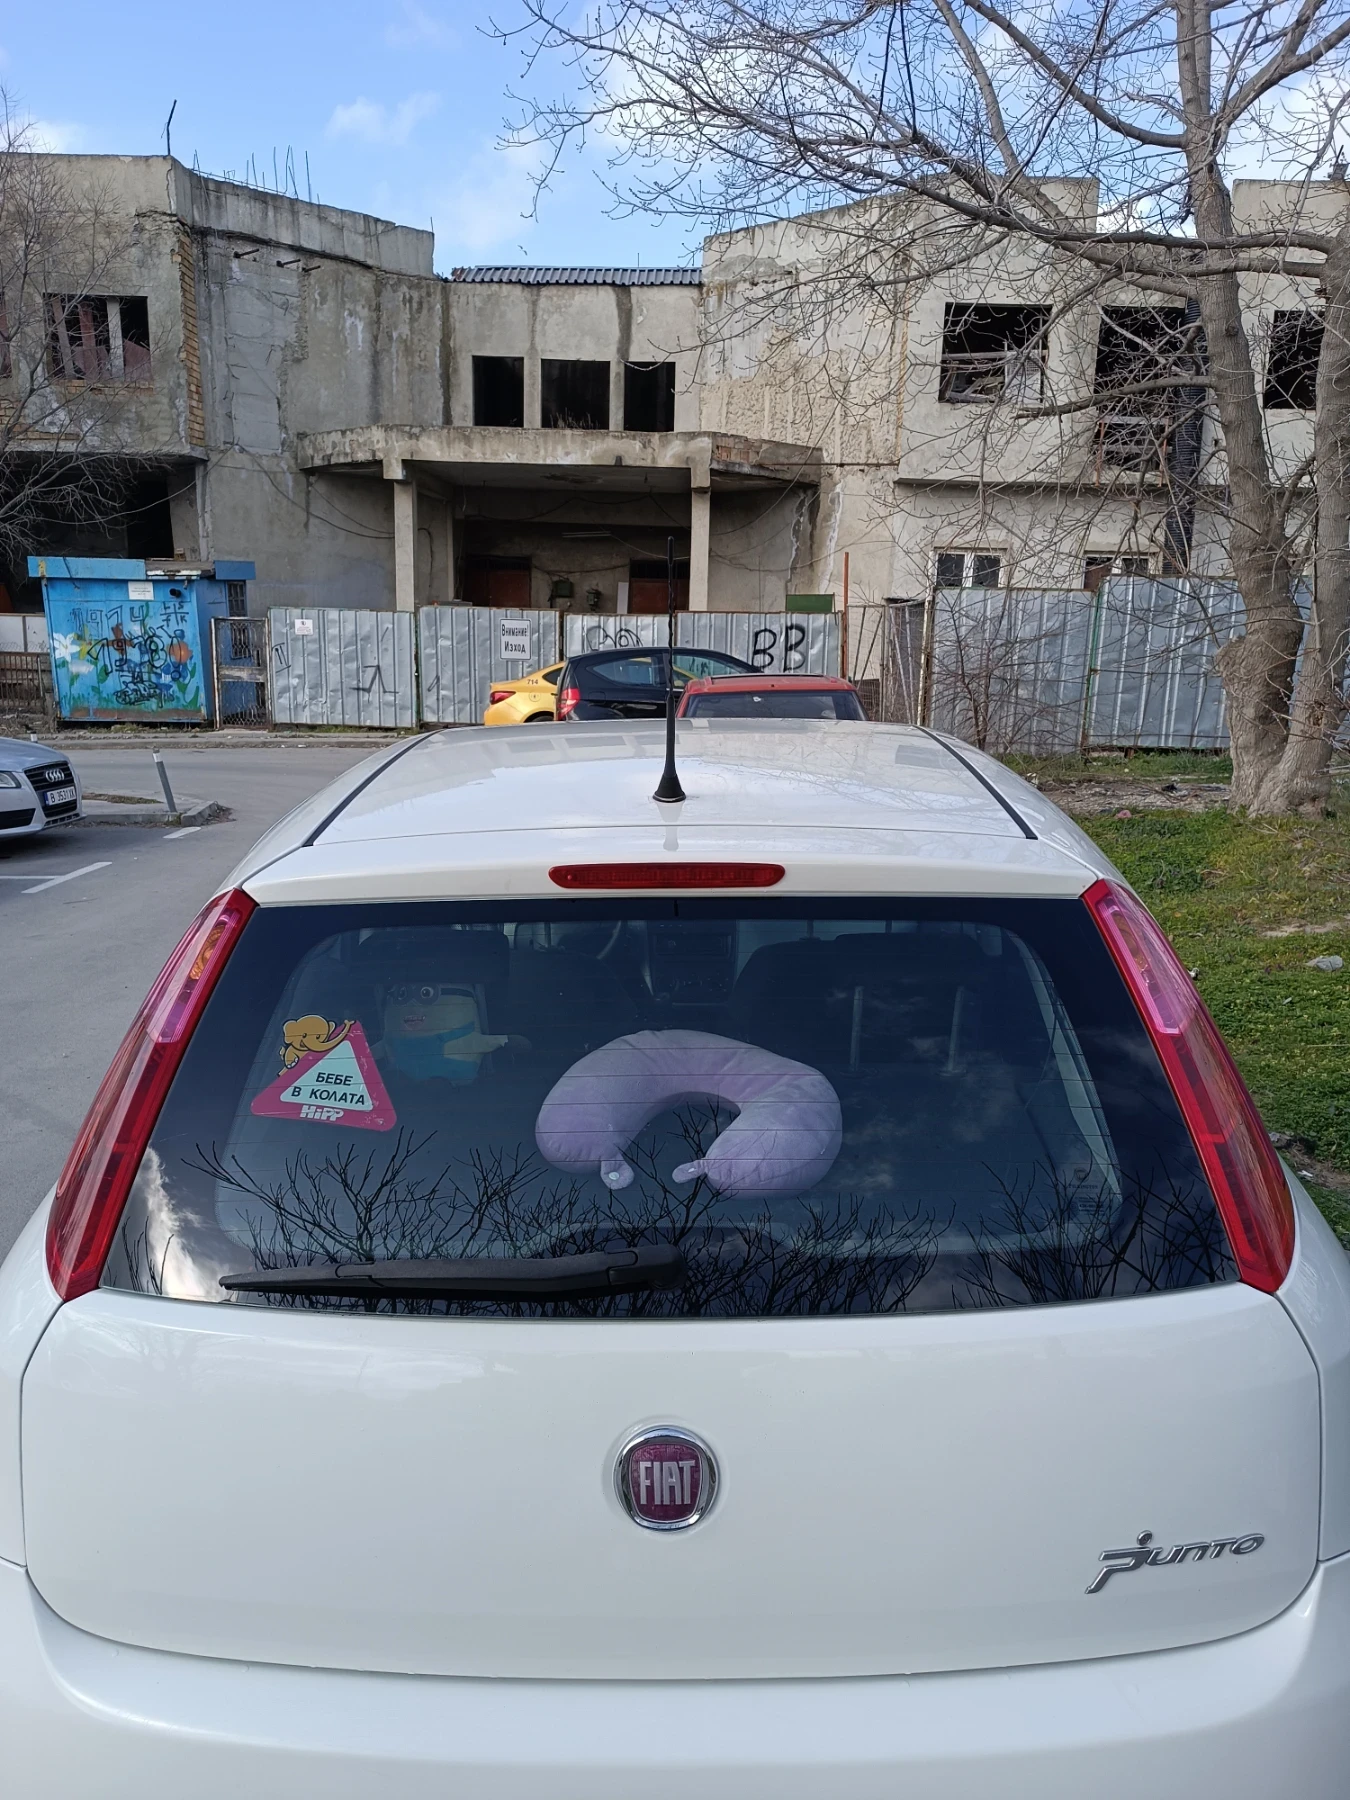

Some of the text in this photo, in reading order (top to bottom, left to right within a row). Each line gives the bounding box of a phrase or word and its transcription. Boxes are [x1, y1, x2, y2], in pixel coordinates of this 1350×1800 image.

[504, 640, 526, 654] Изход
[315, 1072, 353, 1086] БЕБЕ
[291, 1086, 365, 1105] В КОЛАТА
[639, 1459, 696, 1505] FIAT
